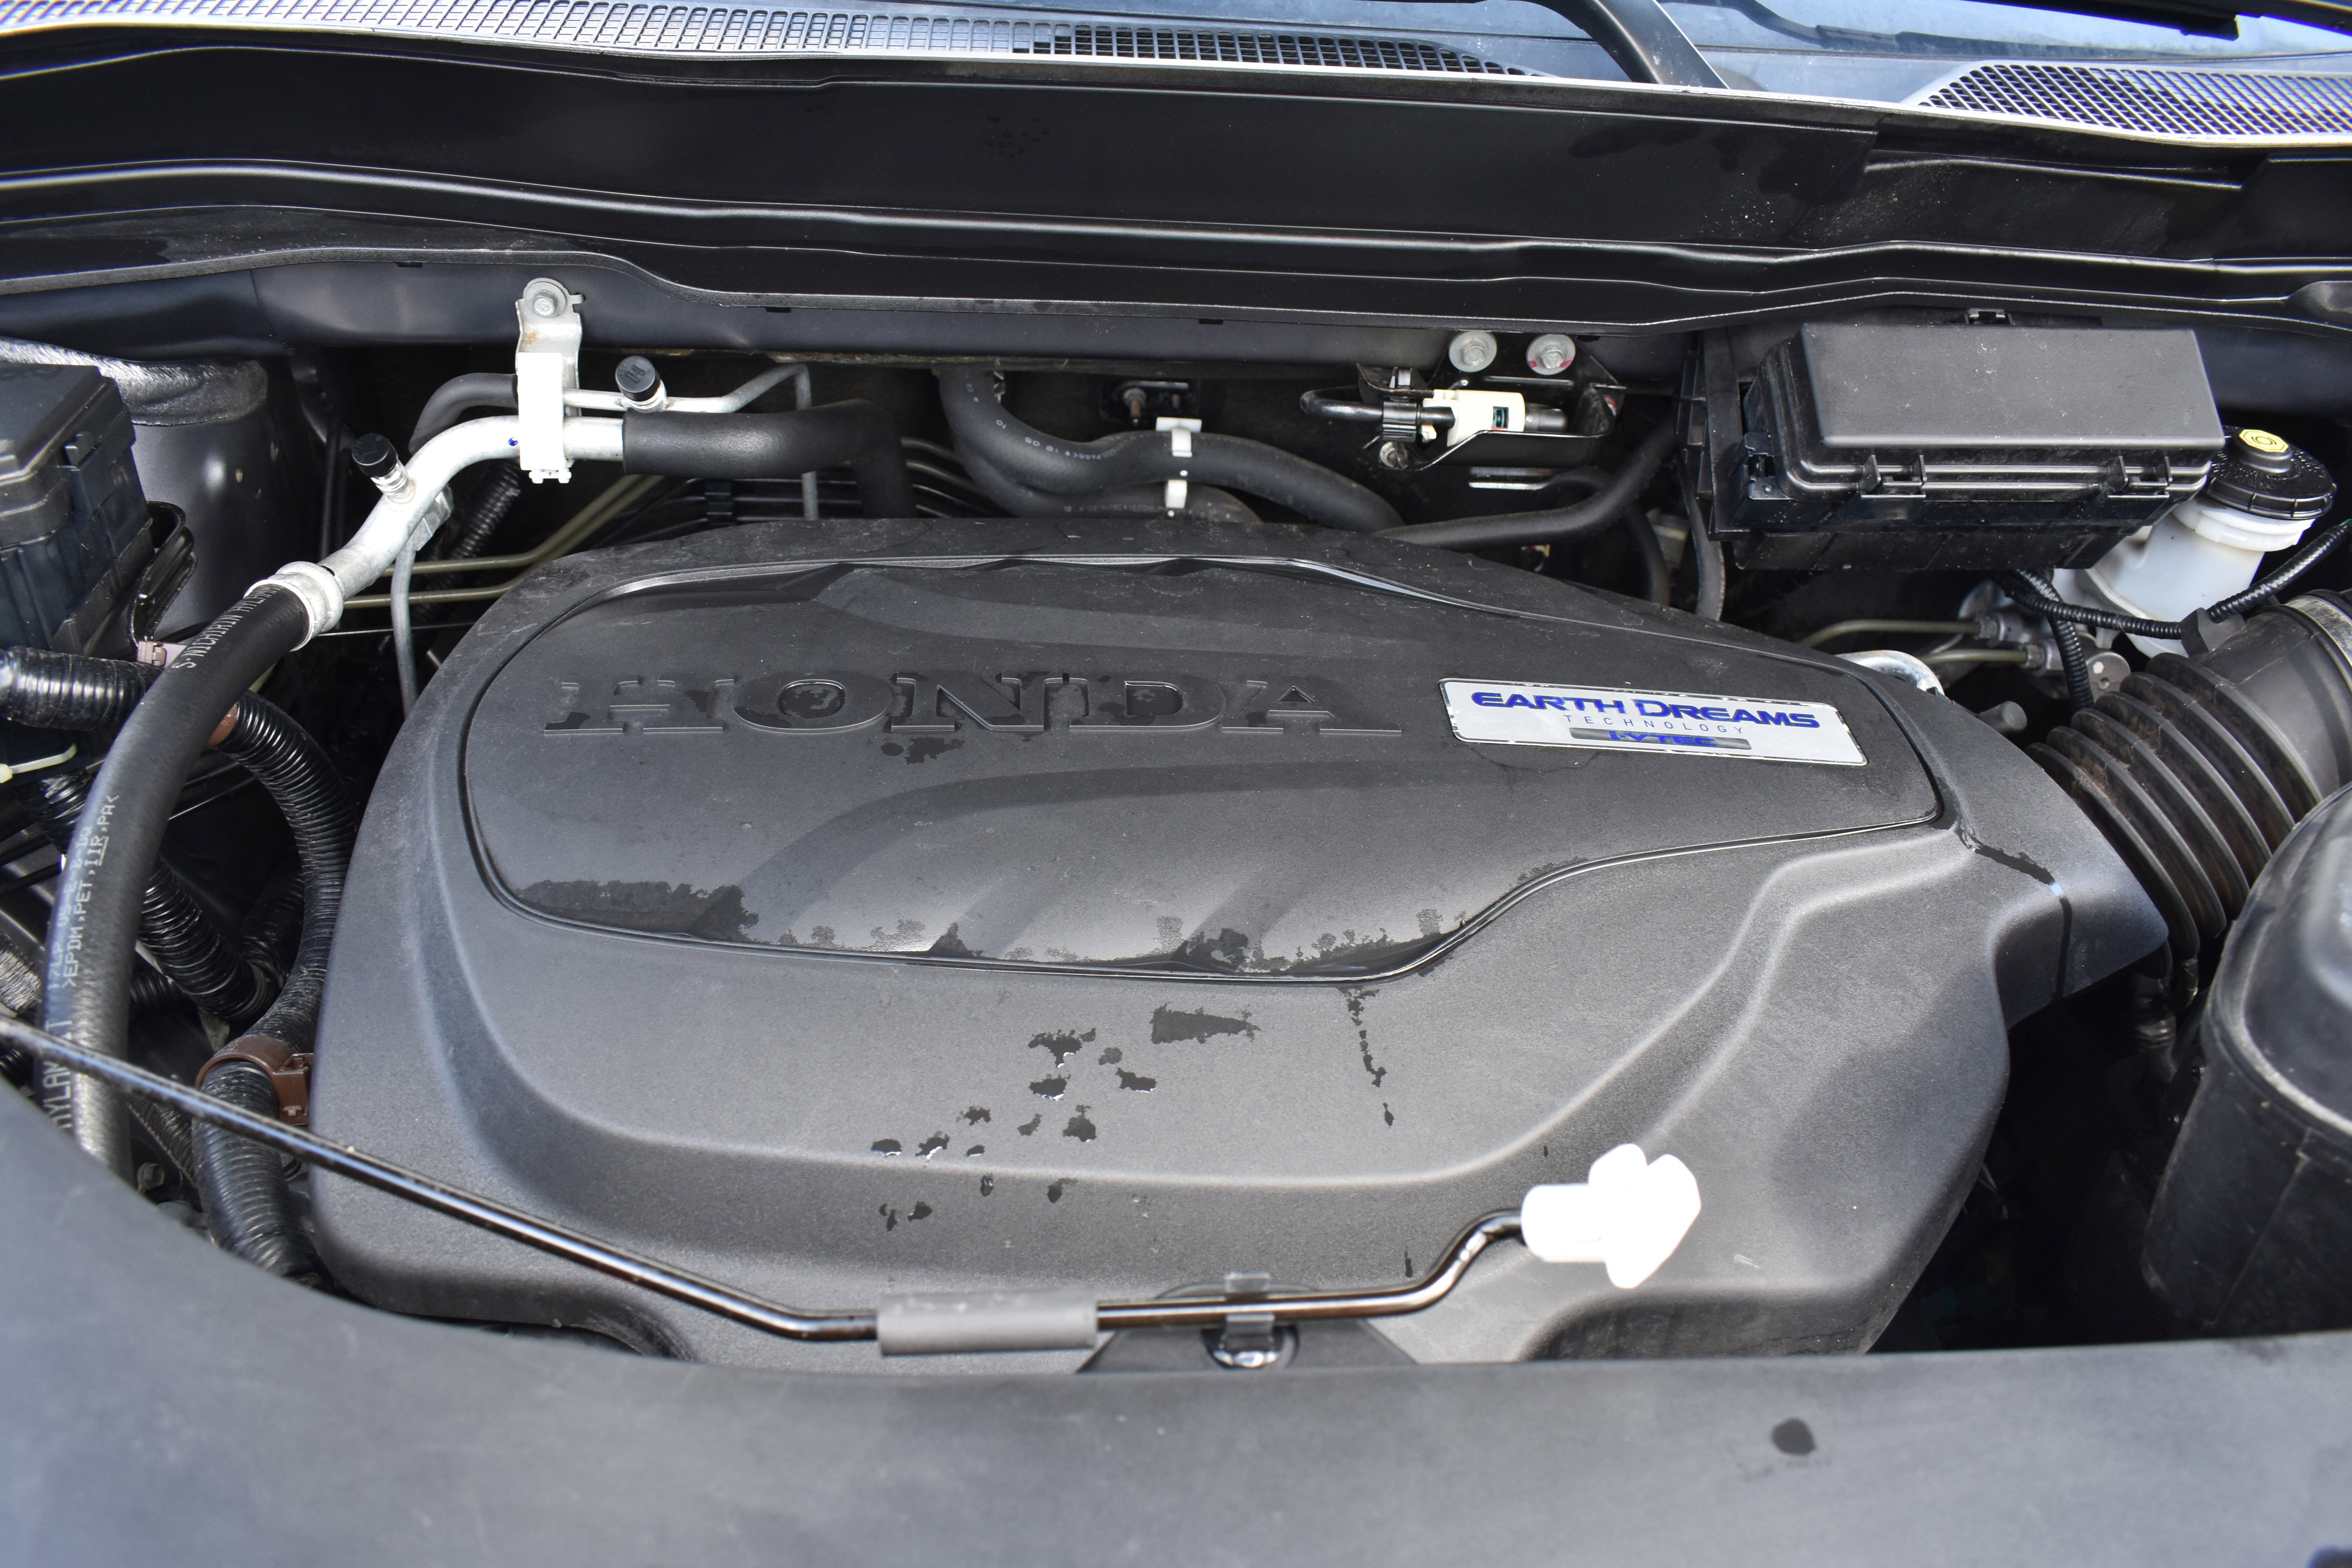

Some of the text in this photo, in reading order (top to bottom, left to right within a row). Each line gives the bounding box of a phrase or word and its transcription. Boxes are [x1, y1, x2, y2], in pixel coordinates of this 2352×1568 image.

[625, 365, 645, 383] H
[544, 674, 1402, 735] HONDA
[1471, 691, 1821, 729] EARTH DREAMS
[1564, 715, 1743, 734] TECHNOLOGY
[1609, 730, 1717, 747] i-VTEC
